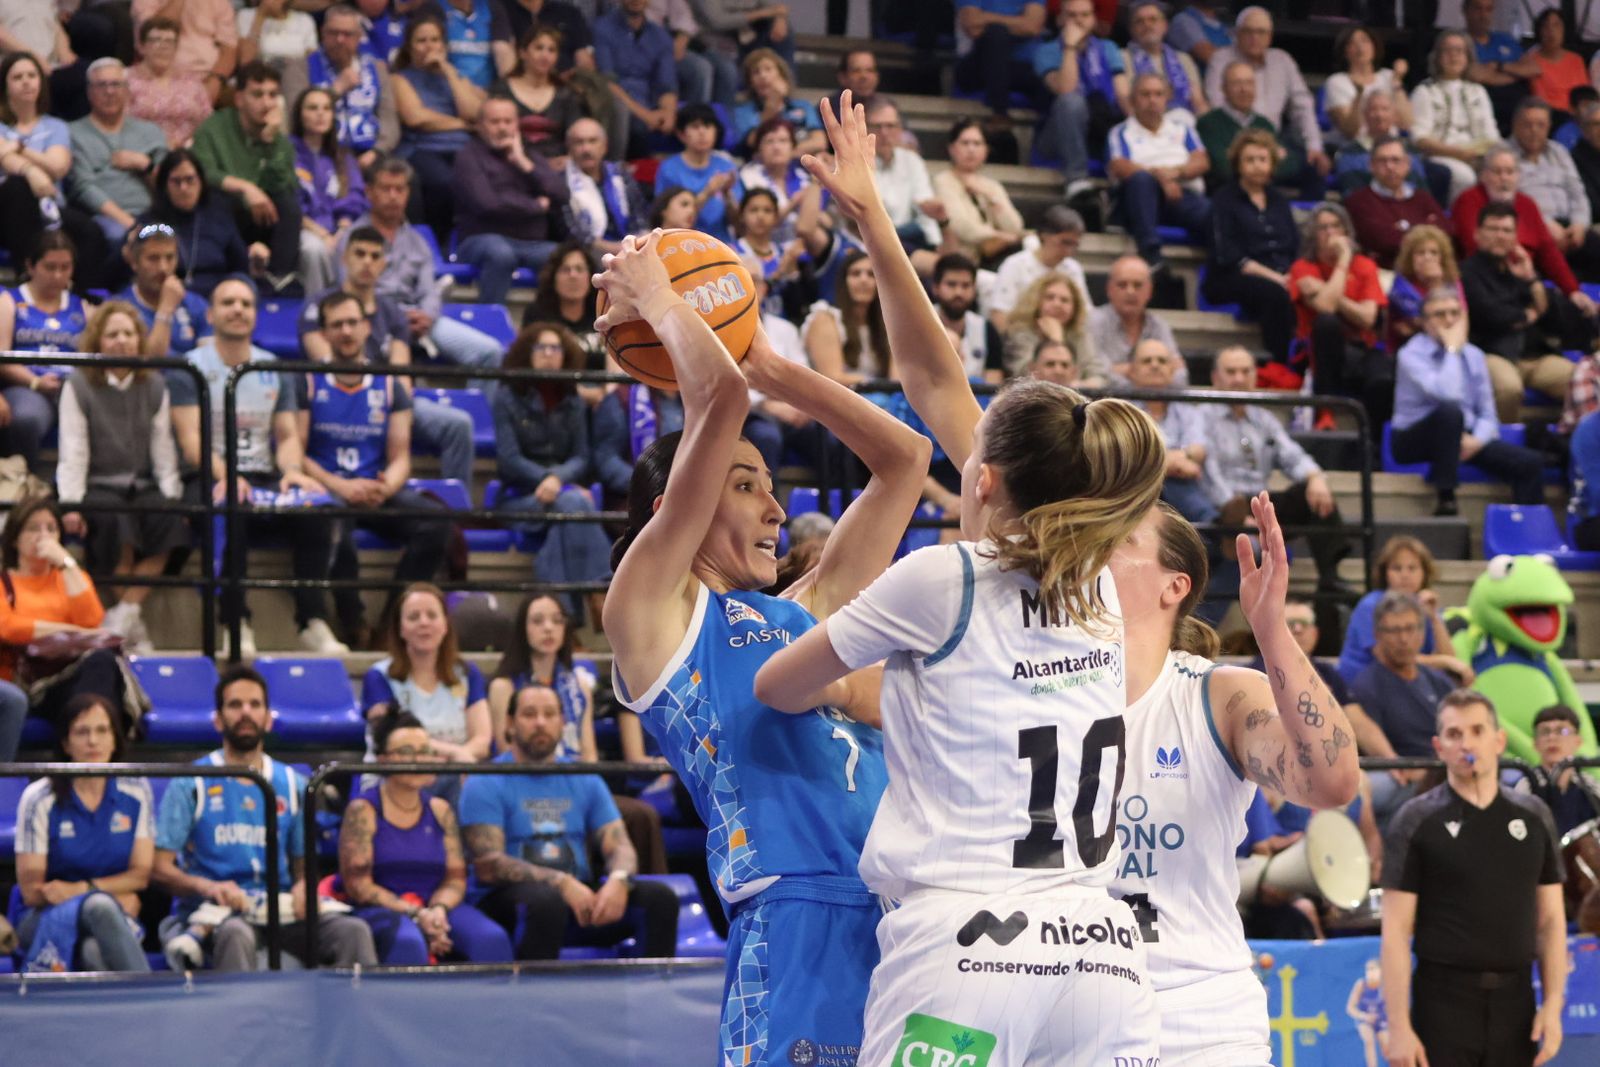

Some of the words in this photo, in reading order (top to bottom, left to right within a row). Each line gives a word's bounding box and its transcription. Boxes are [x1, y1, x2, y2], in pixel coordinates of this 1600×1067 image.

[1012, 648, 1110, 680] Alcantarilla
[1012, 714, 1126, 869] 10
[958, 958, 1070, 976] Conservando
